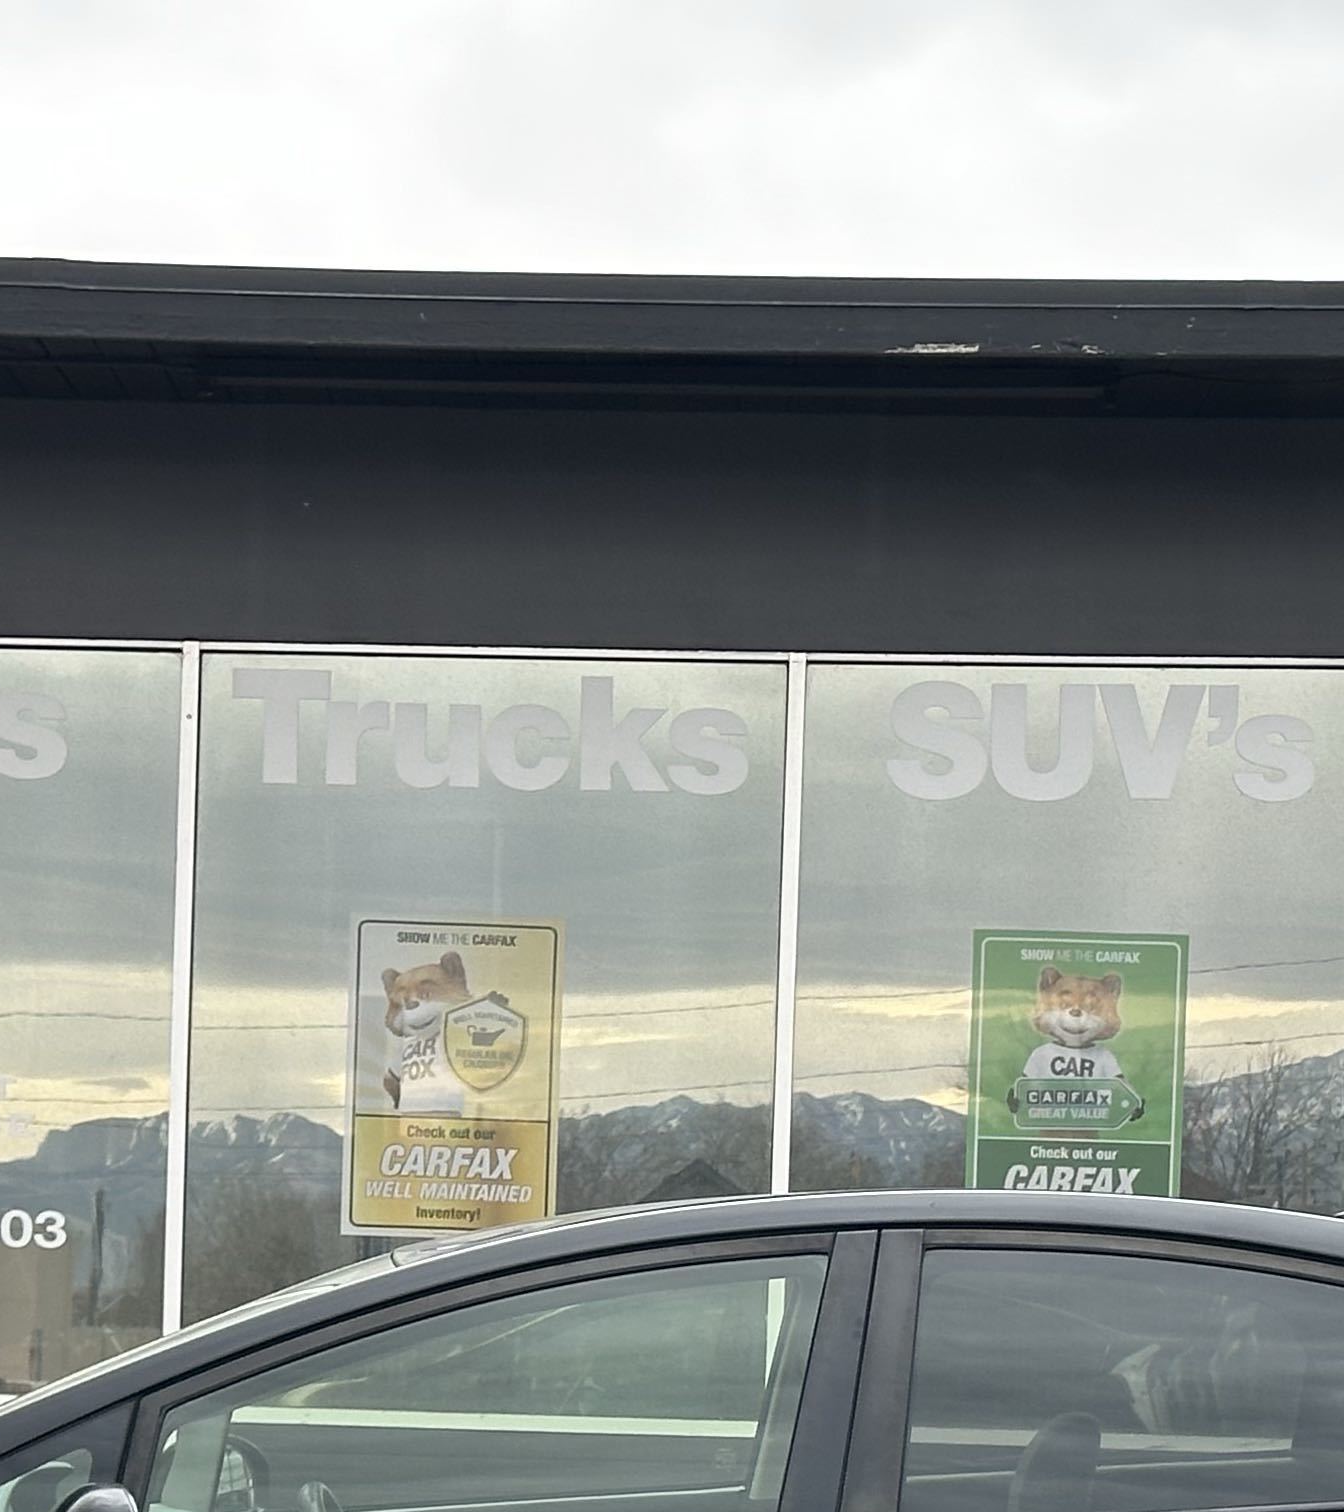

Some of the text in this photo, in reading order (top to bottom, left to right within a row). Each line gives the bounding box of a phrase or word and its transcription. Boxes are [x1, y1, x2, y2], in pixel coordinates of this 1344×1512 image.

[232, 668, 749, 796] Trucks
[886, 681, 1315, 802] SUV's
[397, 931, 517, 947] SHOW ME THE CARFAX
[1020, 949, 1054, 961] SHOW
[1075, 950, 1093, 962] THE
[1096, 951, 1142, 963] CARFAX
[402, 1038, 436, 1061] CAR
[401, 1058, 435, 1082] FOX
[1050, 1056, 1096, 1077] CAR
[1027, 1089, 1113, 1105] CARFAX
[1028, 1107, 1109, 1120] GREAT VALUE
[406, 1125, 496, 1140] Check out our
[379, 1144, 519, 1180] CARFAX
[1030, 1146, 1118, 1160] Check out our
[1004, 1165, 1141, 1195] CARFAX
[365, 1180, 533, 1203] WELL MAINTAINED
[416, 1206, 481, 1222] Inventory!
